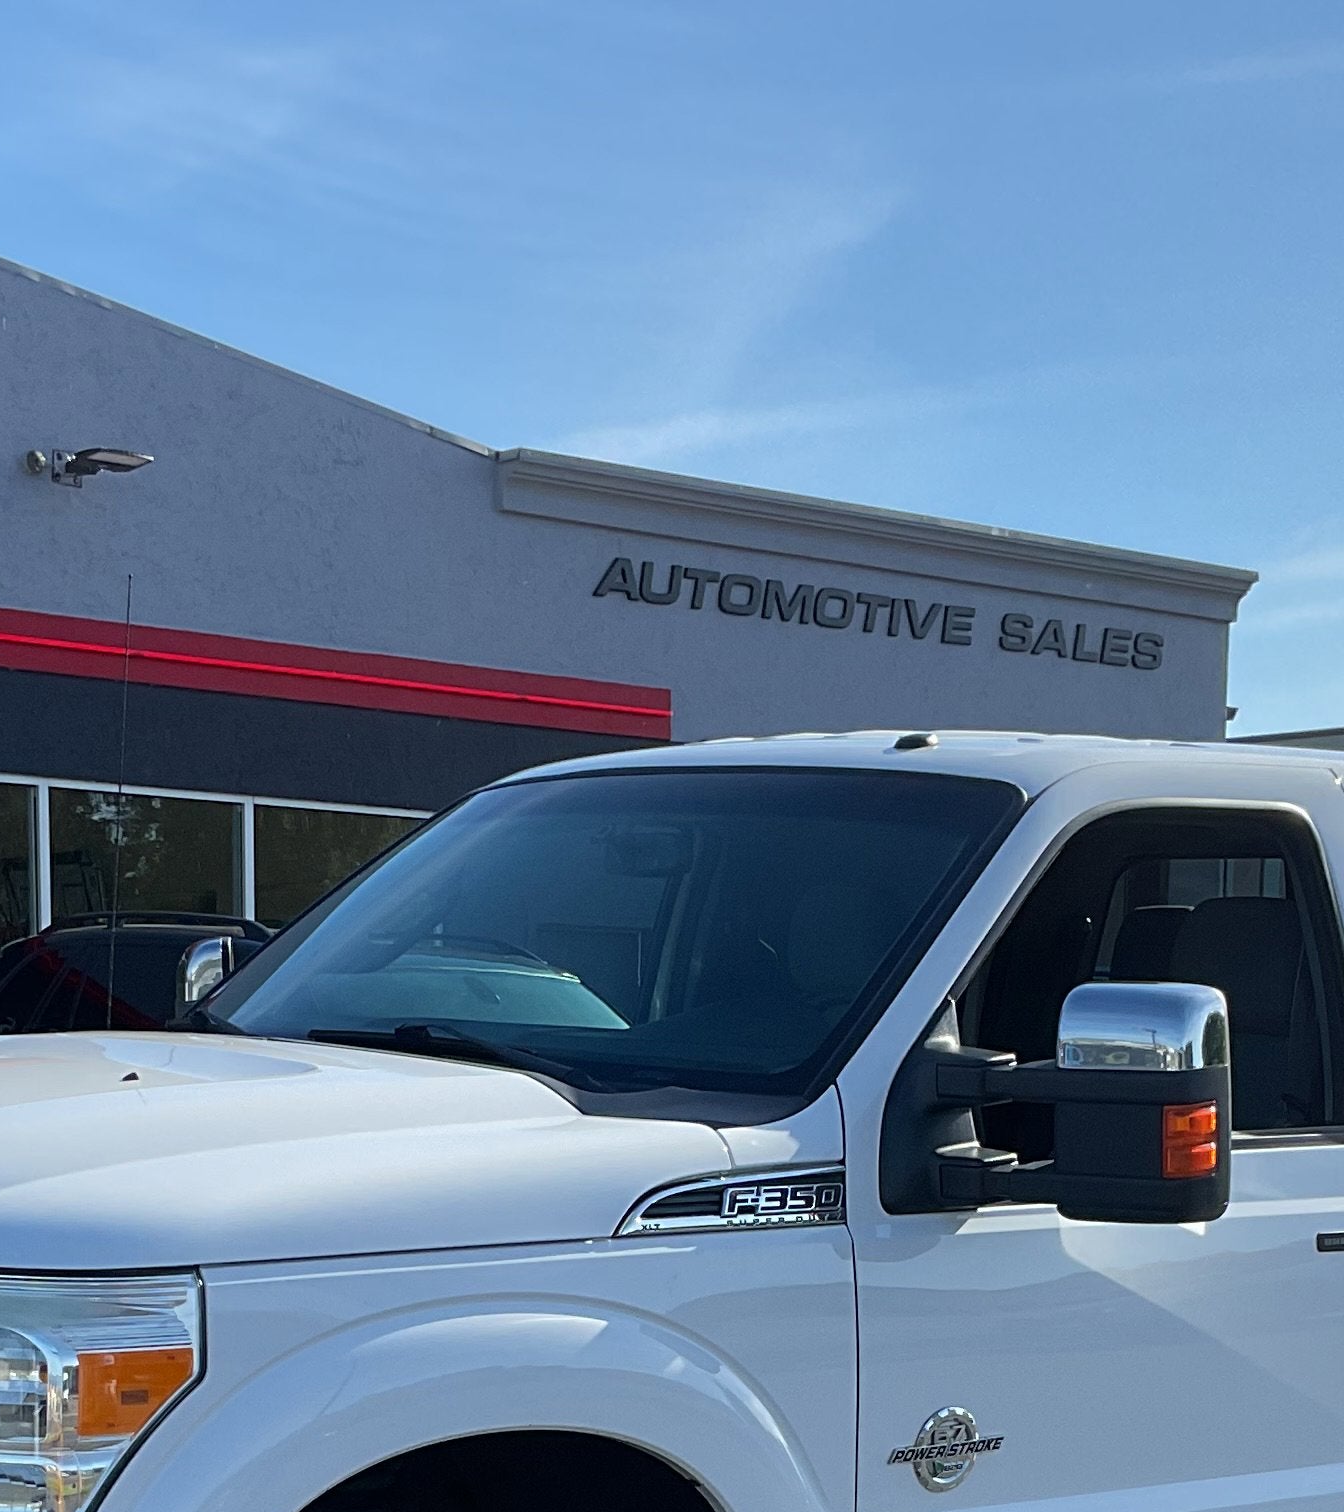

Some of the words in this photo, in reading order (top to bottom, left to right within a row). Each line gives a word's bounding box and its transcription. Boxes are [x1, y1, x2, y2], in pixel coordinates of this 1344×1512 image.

[592, 557, 976, 646] AUTOMOTIVE
[998, 612, 1165, 671] SALES
[723, 1183, 844, 1218] F-350
[641, 1223, 661, 1231] XLT
[726, 1217, 786, 1227] SUPER
[893, 1445, 947, 1463] POWER
[947, 1437, 1004, 1456] STROKE
